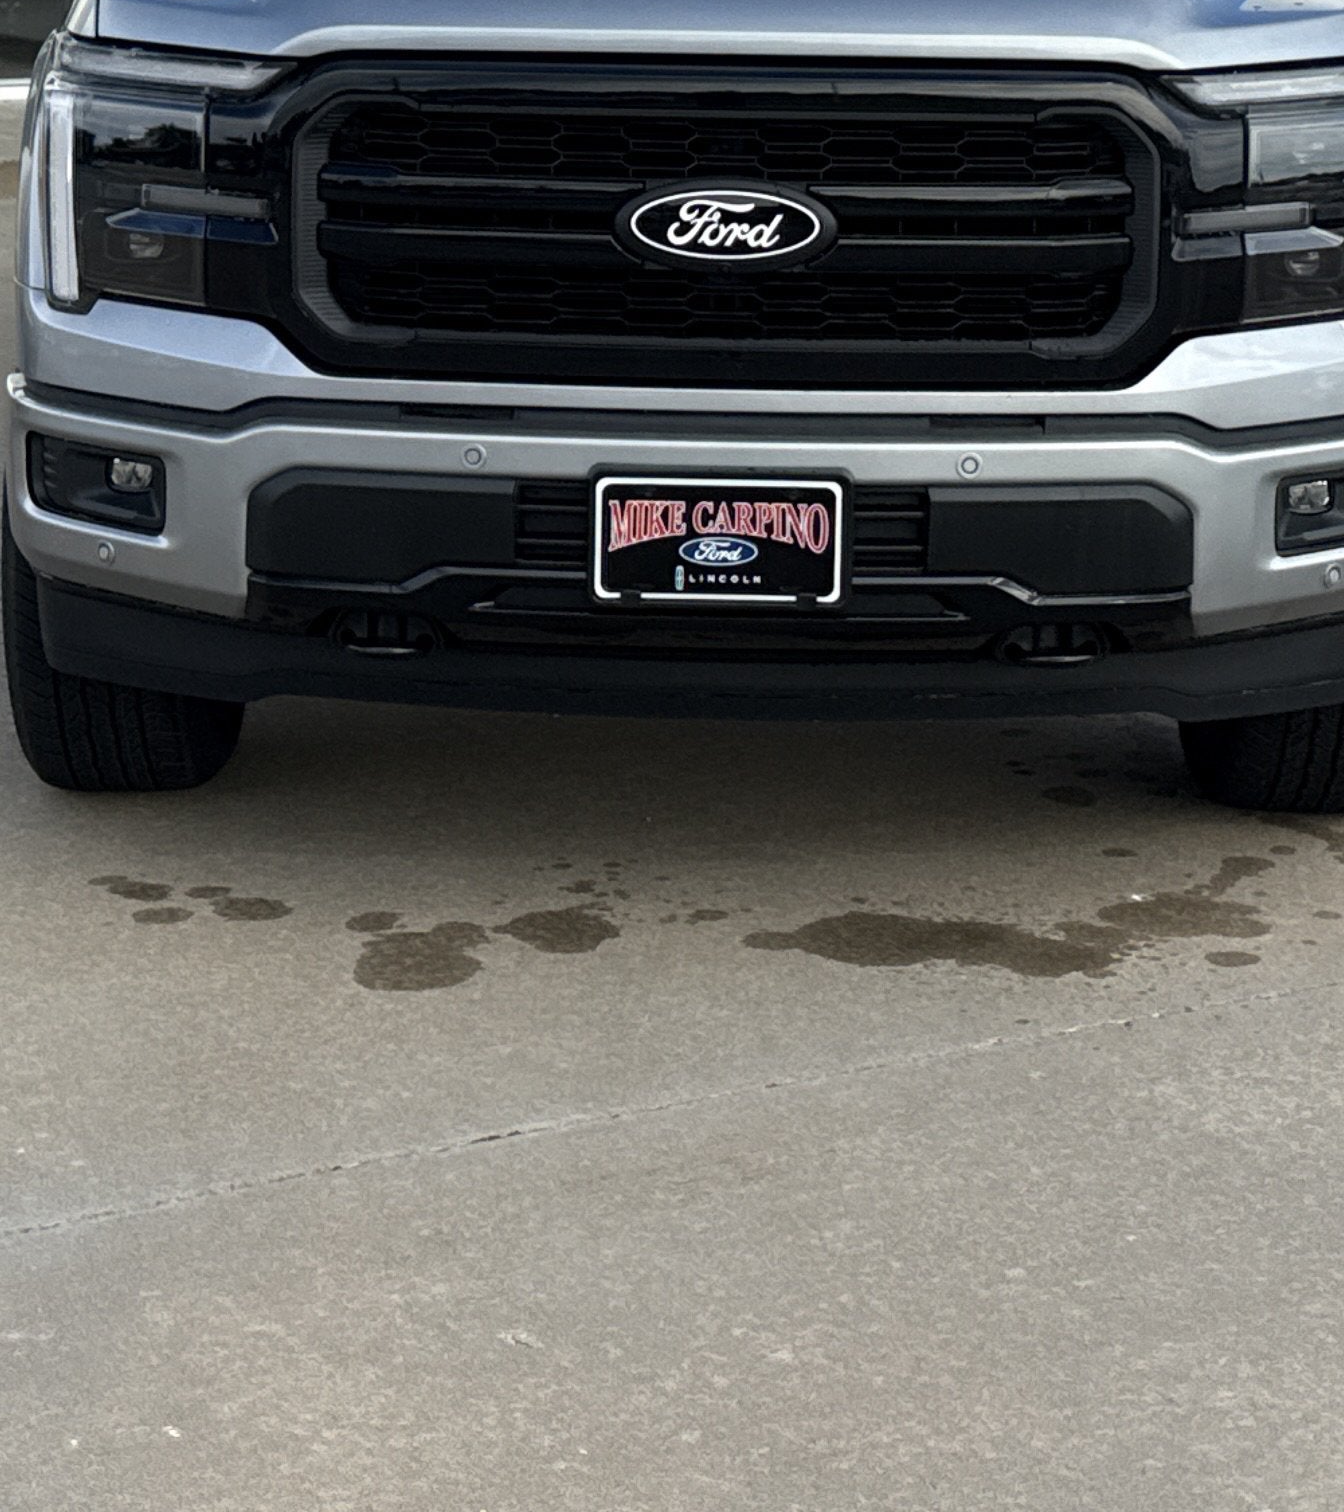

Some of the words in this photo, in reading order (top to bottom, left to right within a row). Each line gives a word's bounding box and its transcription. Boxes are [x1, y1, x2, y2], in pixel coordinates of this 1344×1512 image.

[666, 198, 785, 249] Ford
[608, 499, 687, 553] MIKE
[691, 500, 830, 555] CARPINO
[693, 541, 744, 562] Ford
[688, 573, 762, 584] LINCOLN
